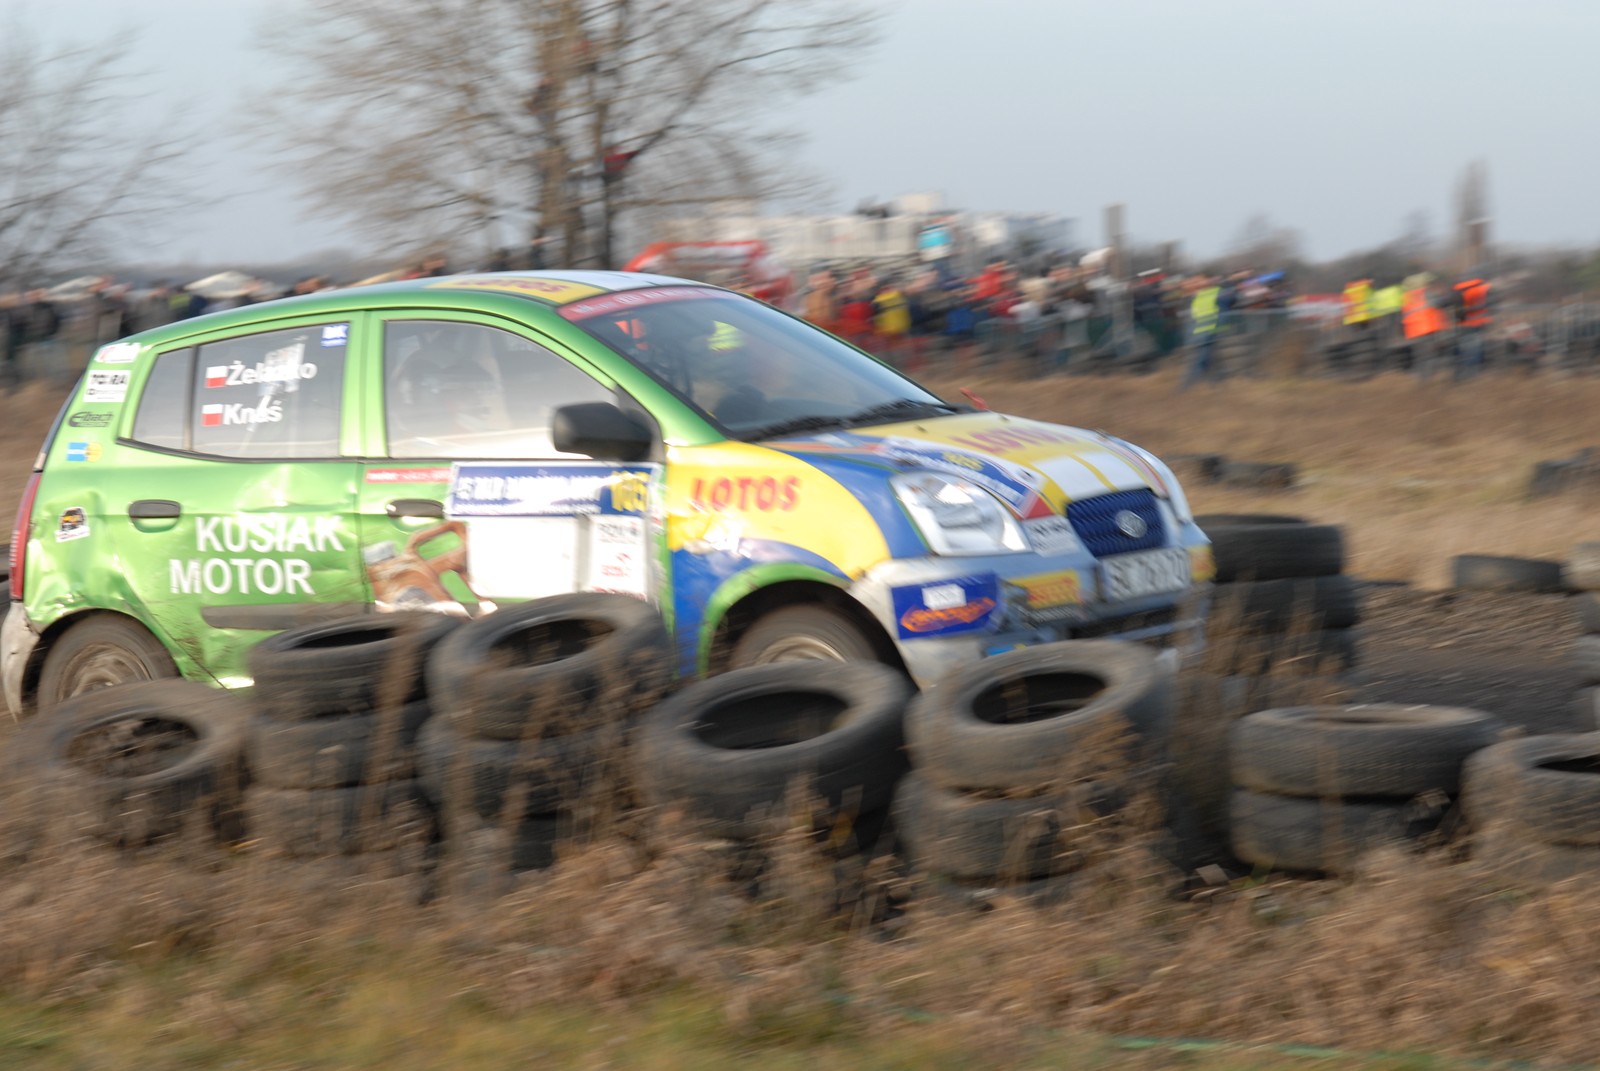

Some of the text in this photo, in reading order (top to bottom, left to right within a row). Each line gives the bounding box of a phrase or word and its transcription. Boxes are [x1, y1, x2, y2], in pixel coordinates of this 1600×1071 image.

[225, 359, 318, 386] Żelo
[222, 399, 283, 426] Knś
[689, 475, 802, 512] LOTOS
[195, 514, 346, 553] KUSIAK
[168, 557, 316, 595] MOTOR
